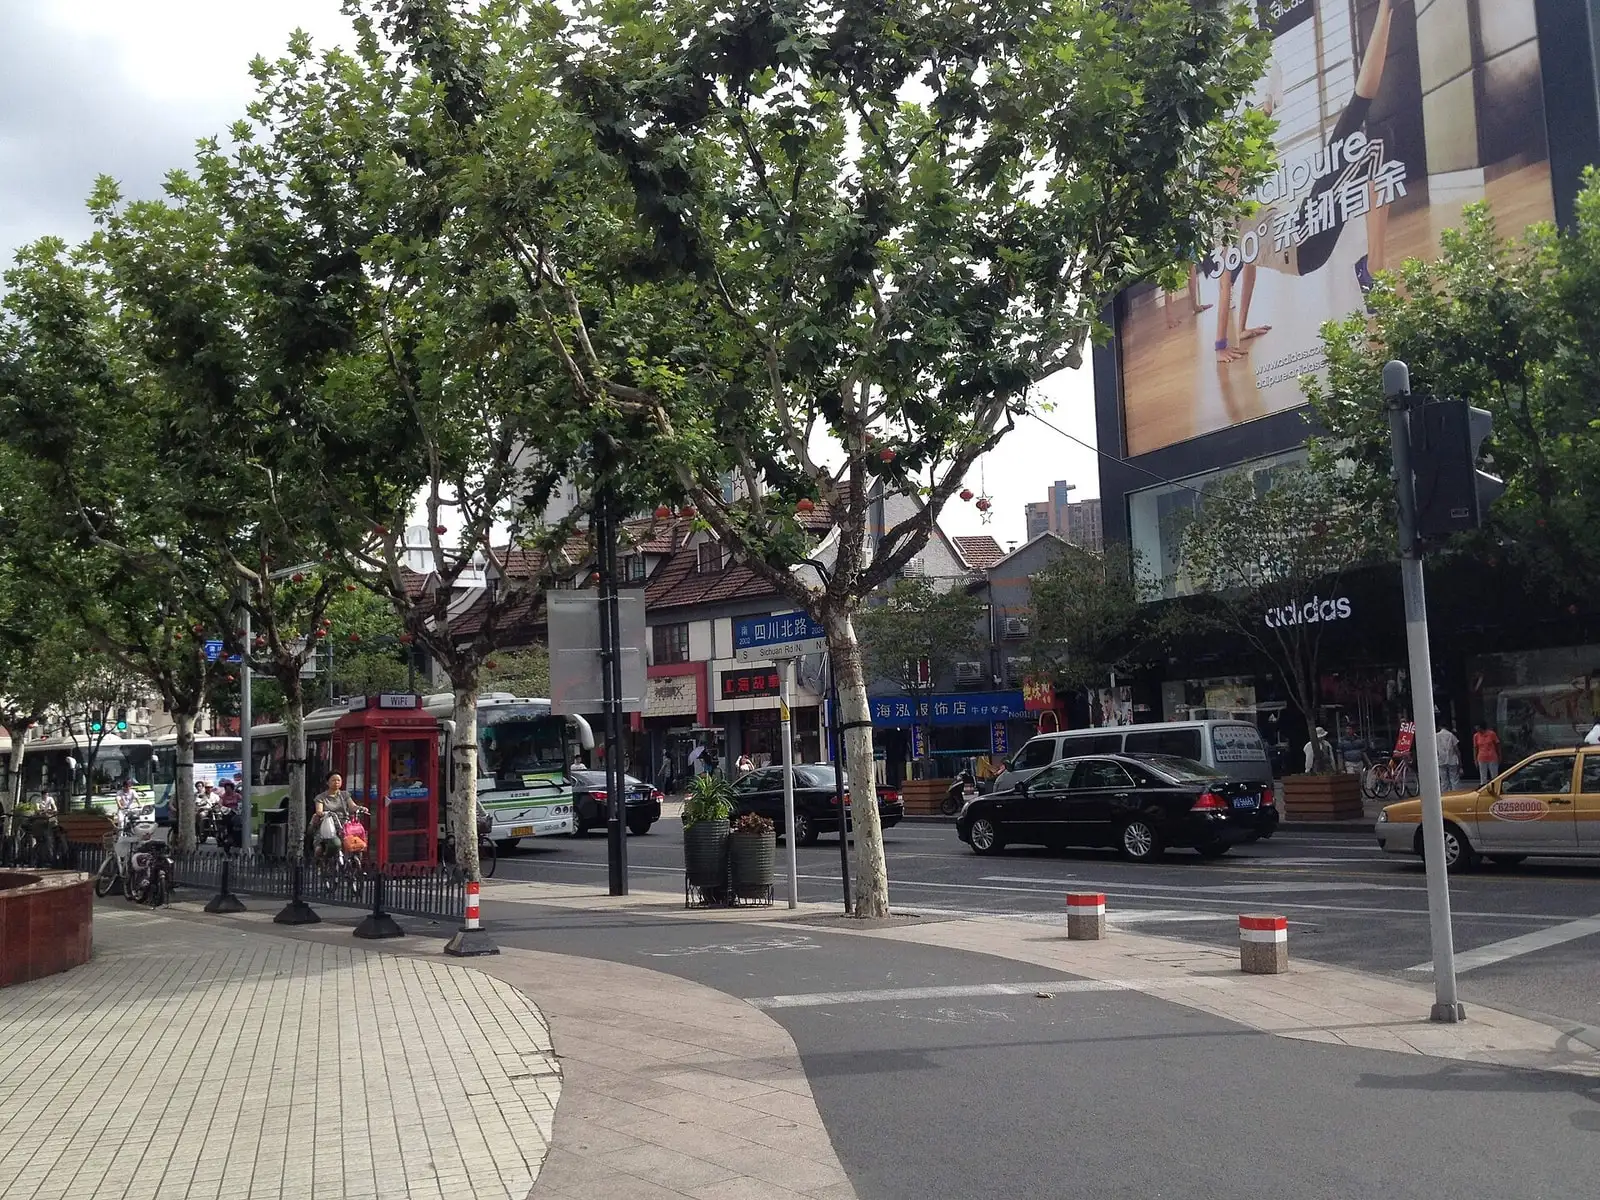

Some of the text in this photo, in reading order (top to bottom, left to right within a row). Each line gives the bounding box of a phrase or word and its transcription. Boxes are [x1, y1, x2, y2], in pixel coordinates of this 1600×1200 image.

[1244, 131, 1368, 204] dipure
[1264, 595, 1351, 627] adidas
[741, 617, 807, 640] 南 四川北路
[743, 651, 747, 660] S
[760, 648, 782, 657] Sichuan
[816, 641, 821, 650] N
[876, 701, 967, 717] 海泓服饰店
[1400, 721, 1416, 734] sale
